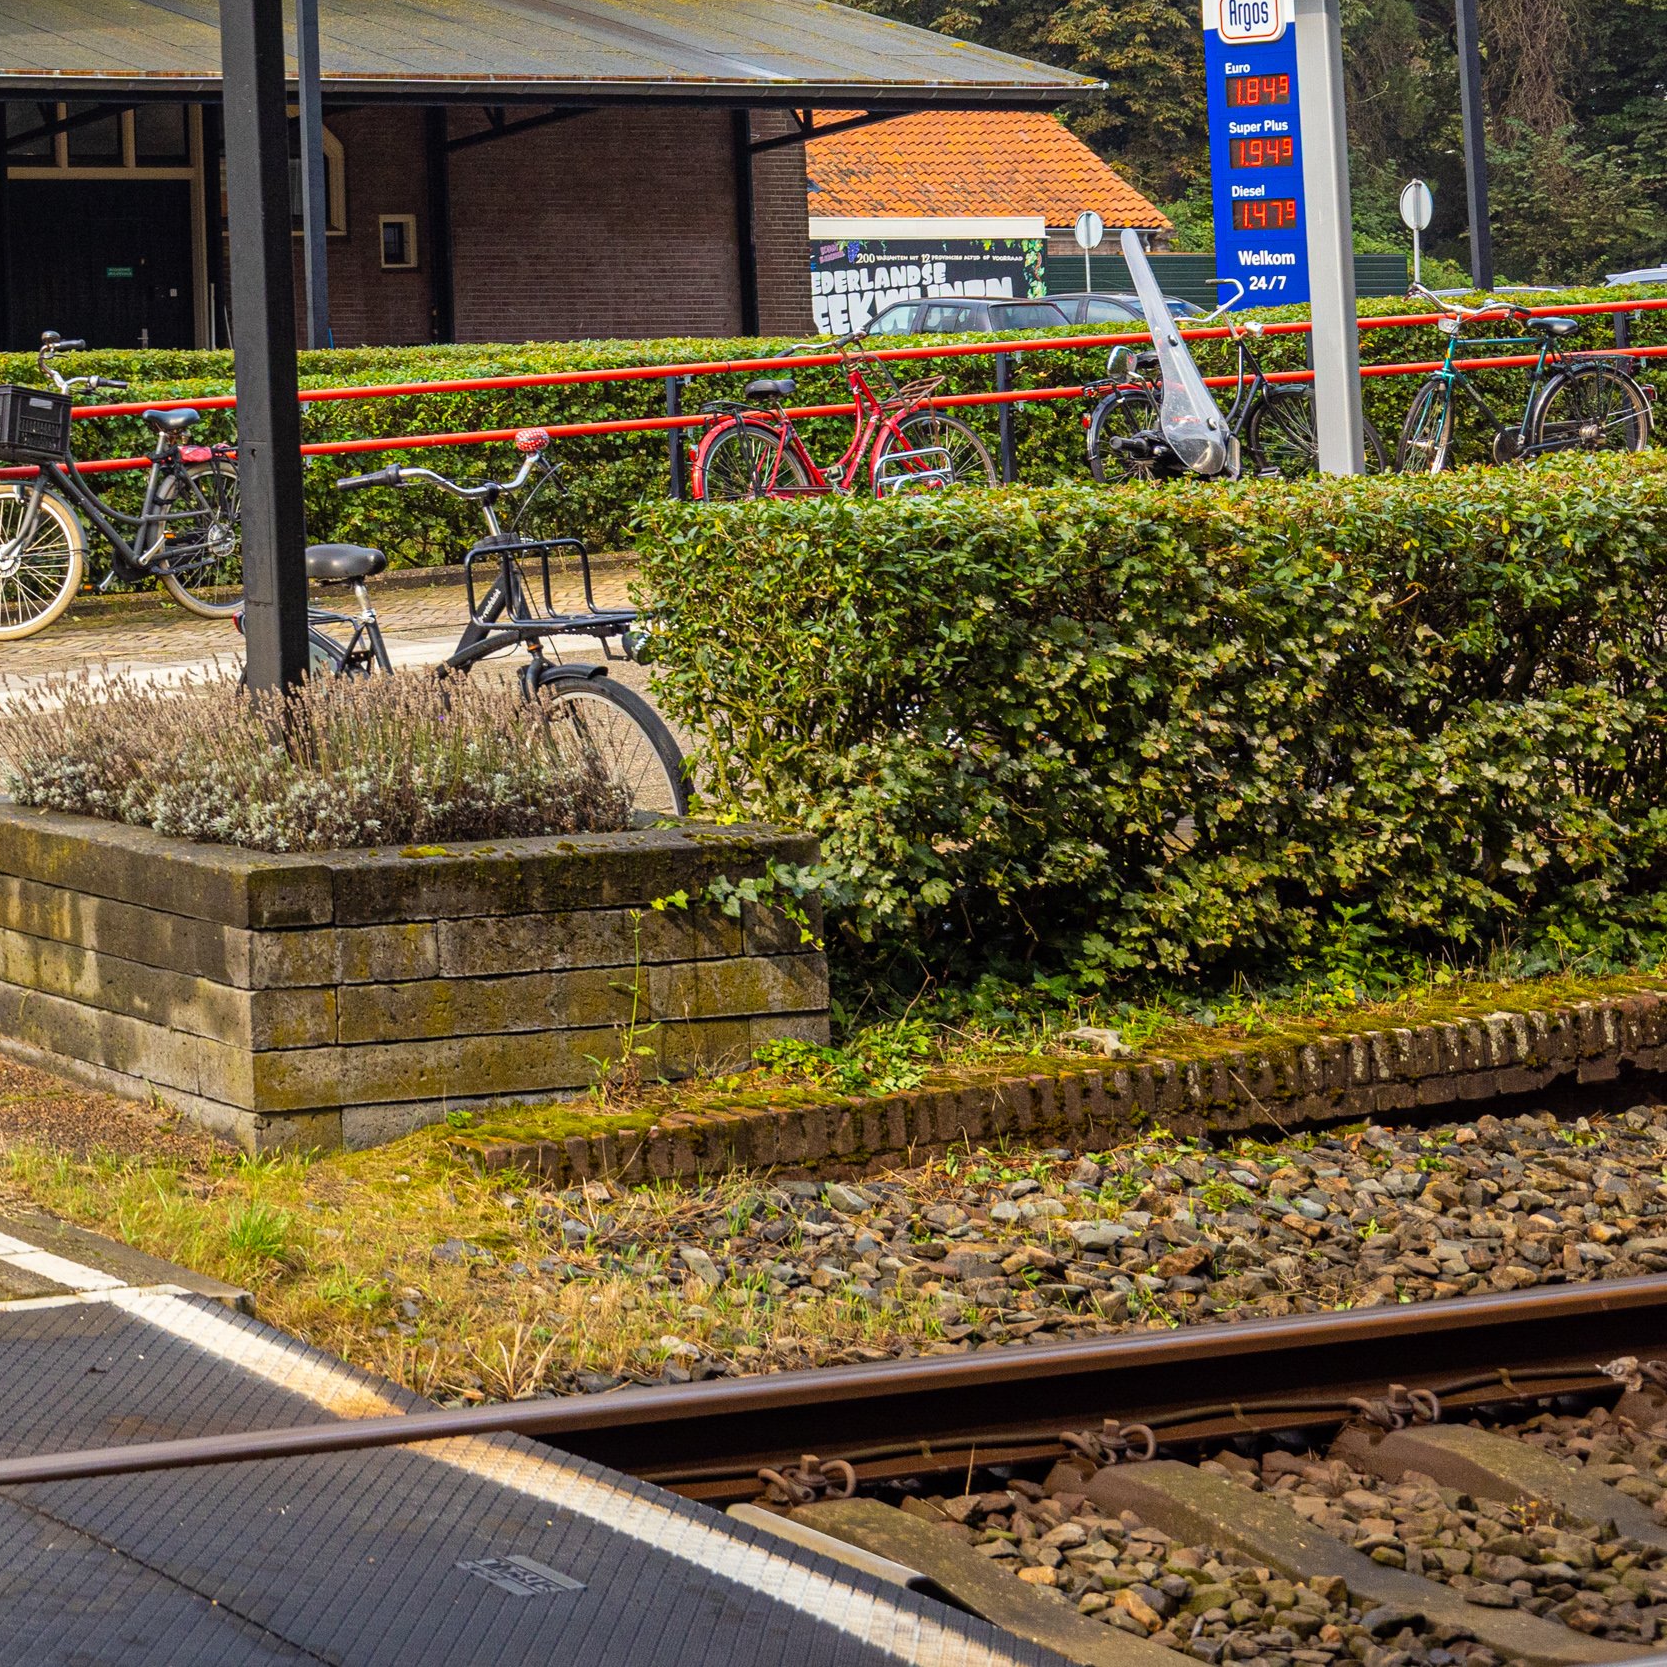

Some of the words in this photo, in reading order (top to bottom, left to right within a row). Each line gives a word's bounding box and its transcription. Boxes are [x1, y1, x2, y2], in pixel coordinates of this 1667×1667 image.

[1224, 62, 1251, 74] Euro
[1229, 122, 1262, 135] Super
[1264, 120, 1288, 131] Plus
[1231, 184, 1265, 198] Diesel
[856, 253, 875, 264] 200
[921, 253, 931, 263] 12
[1238, 250, 1296, 266] Welkom
[811, 262, 947, 296] EDERLANDSE
[1249, 275, 1287, 291] 24/7
